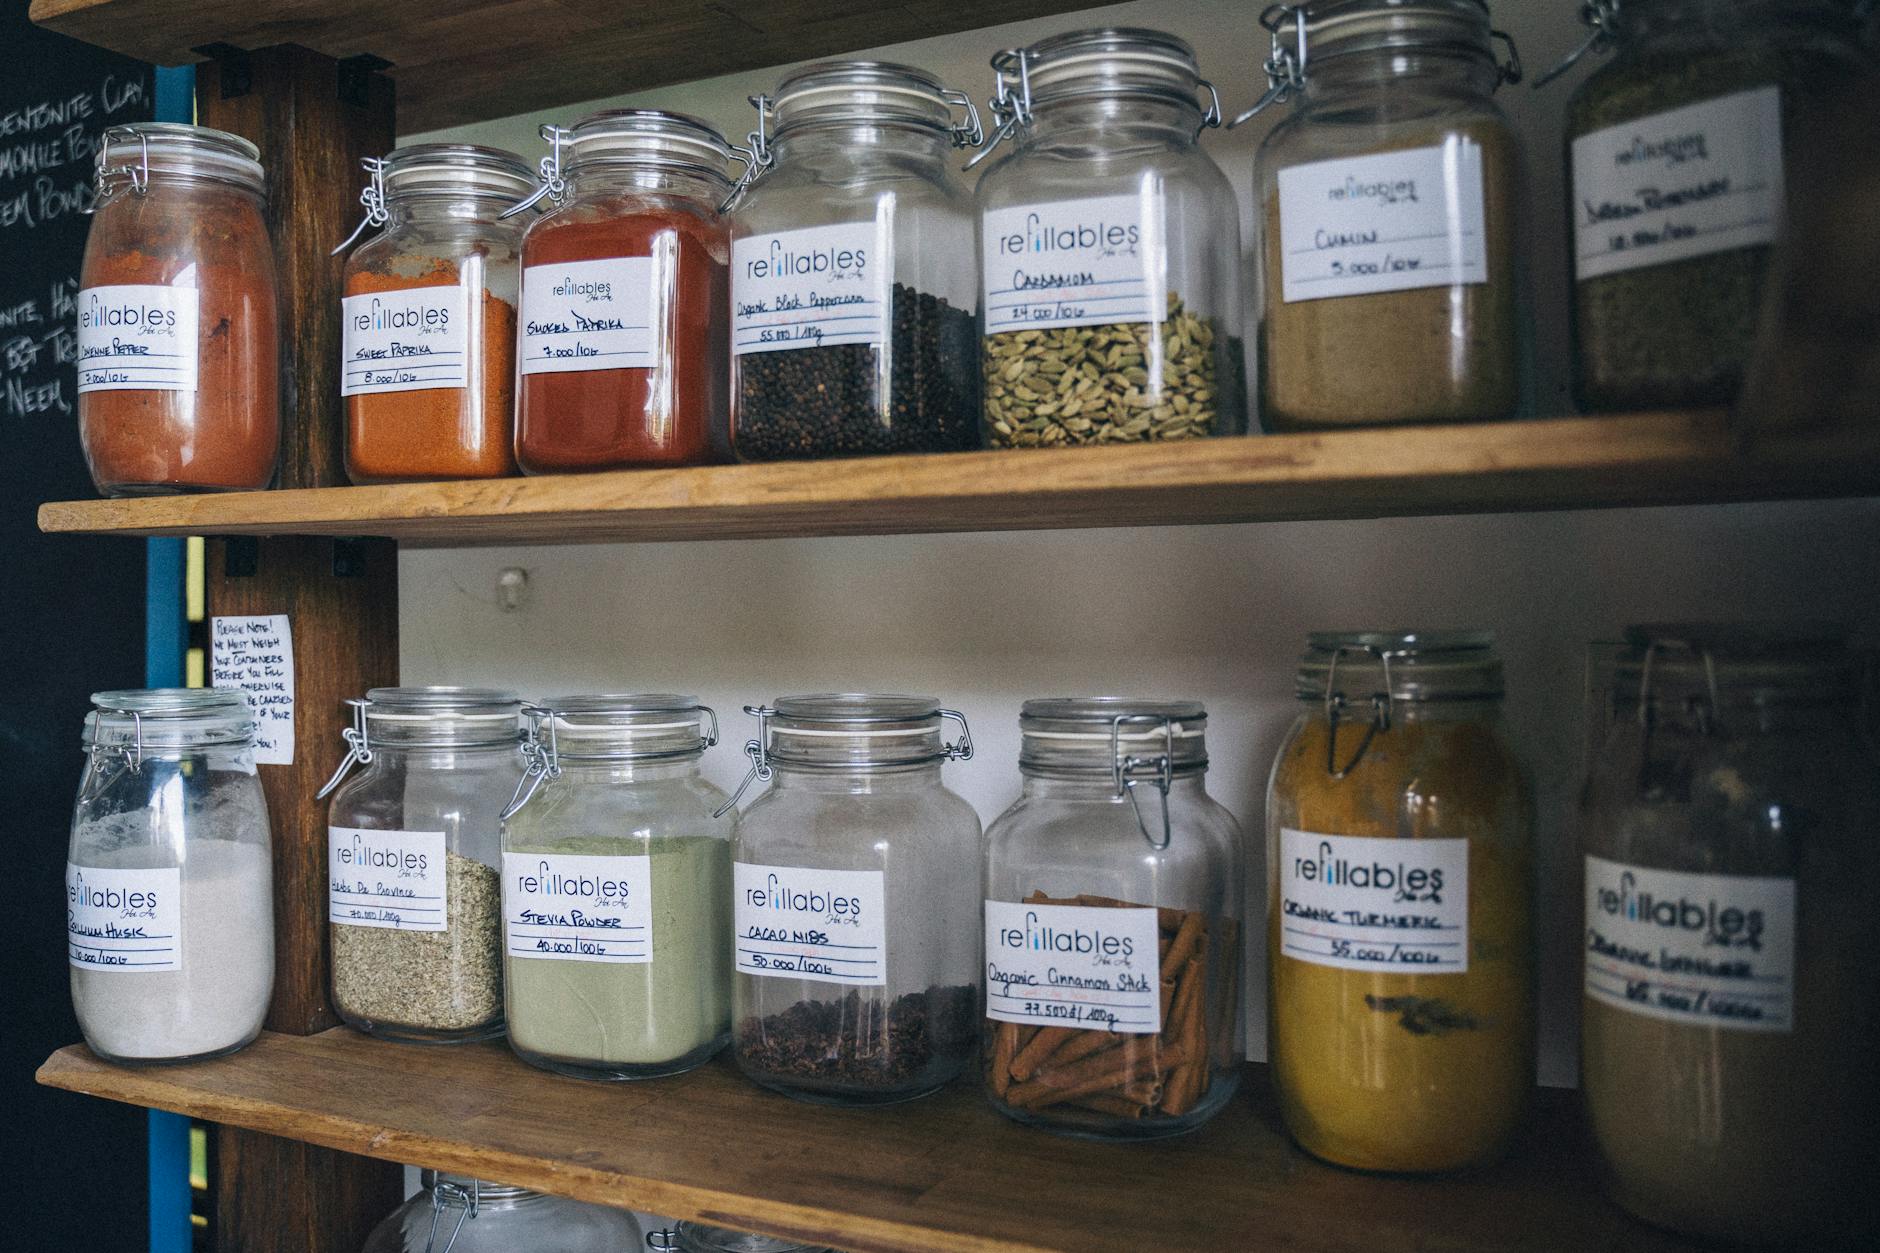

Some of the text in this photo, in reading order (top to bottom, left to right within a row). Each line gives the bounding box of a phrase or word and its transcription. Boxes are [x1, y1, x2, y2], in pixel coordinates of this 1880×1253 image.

[1000, 213, 1139, 255] refillables
[748, 239, 866, 280] refillables
[552, 276, 612, 296] refillables
[80, 294, 176, 328] refillables
[353, 298, 449, 331] refillables
[337, 834, 428, 870] refillables
[1295, 841, 1444, 891] refillables
[519, 860, 629, 897] refillables
[747, 873, 861, 915] refillables
[519, 909, 622, 929] STEVIA POWDER
[749, 925, 829, 945] CACAO NIBS
[1000, 911, 1134, 956] refillables
[988, 962, 1038, 998] Organic
[1048, 967, 1110, 991] Cinnamon
